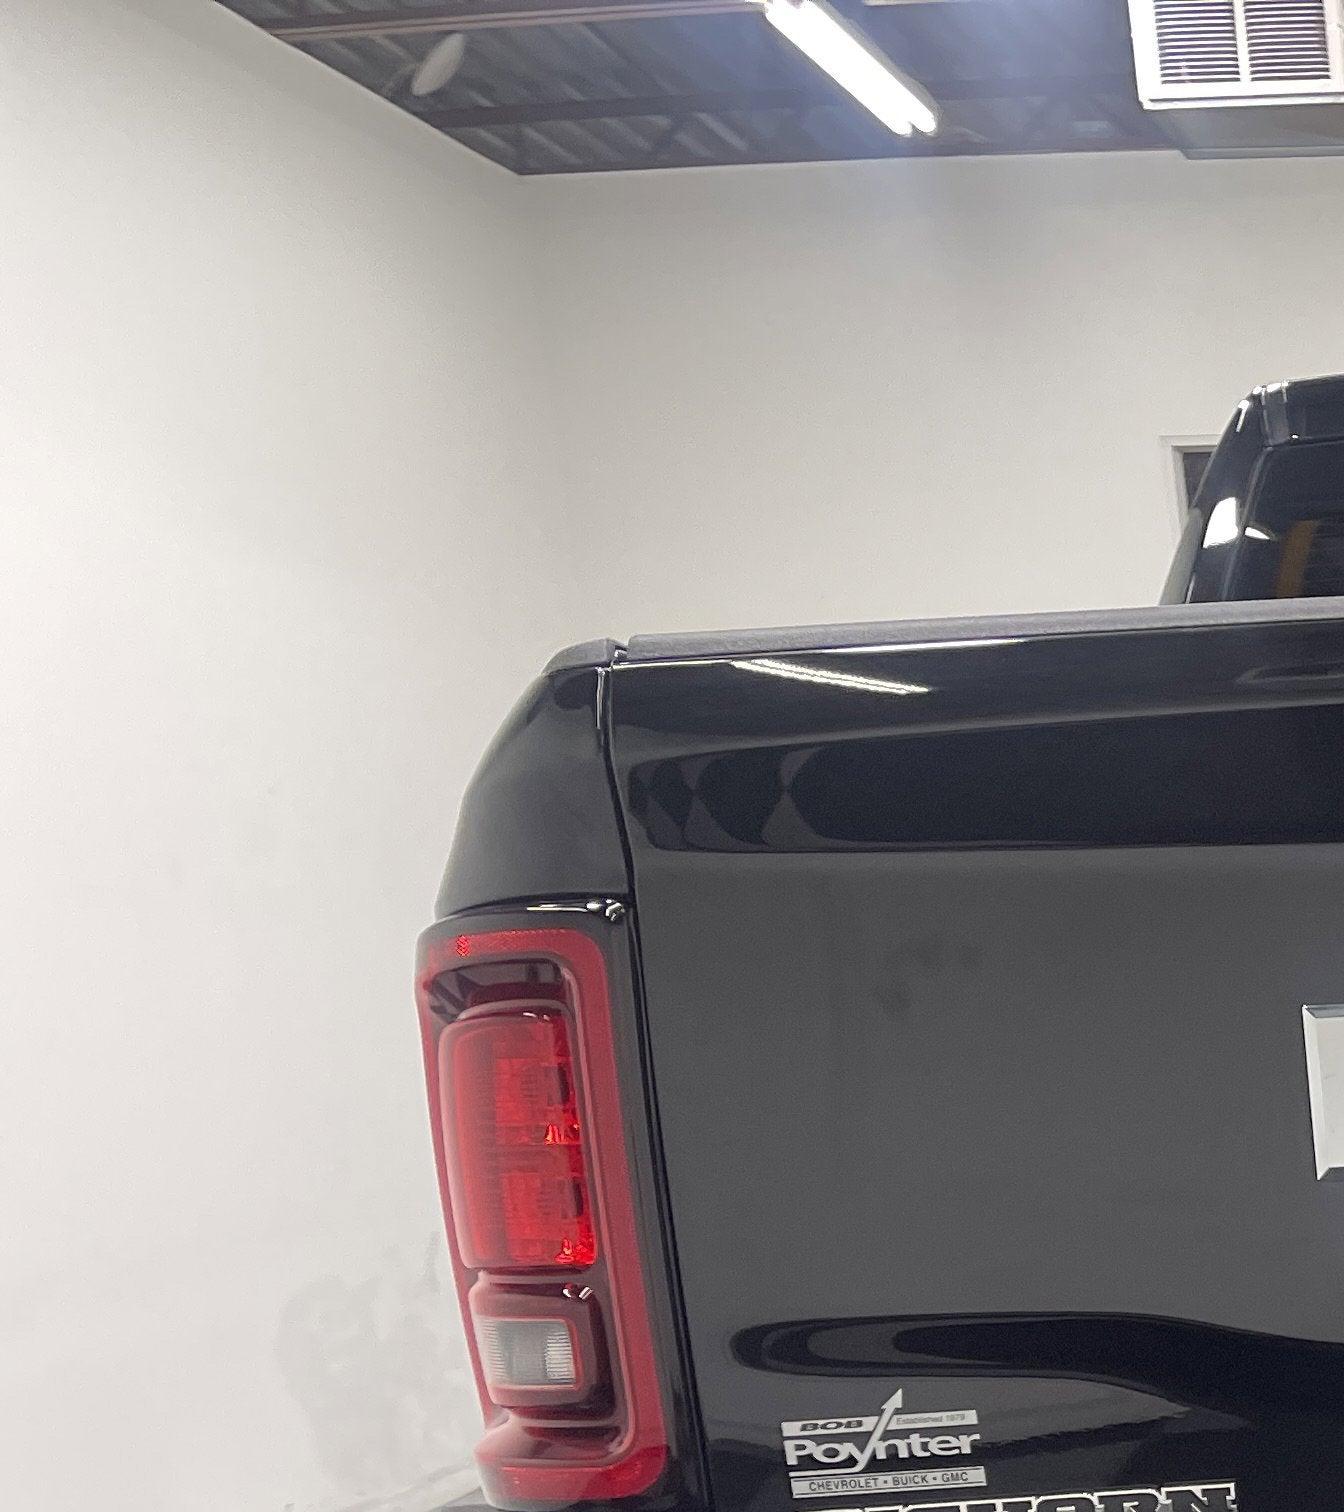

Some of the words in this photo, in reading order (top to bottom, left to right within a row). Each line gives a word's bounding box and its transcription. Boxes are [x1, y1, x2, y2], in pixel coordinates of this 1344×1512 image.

[800, 1418, 864, 1433] BOB
[783, 1432, 981, 1467] Poynter
[808, 1477, 880, 1492] CHEVROLET
[892, 1474, 929, 1487] BUICK
[941, 1471, 969, 1483] GMC
